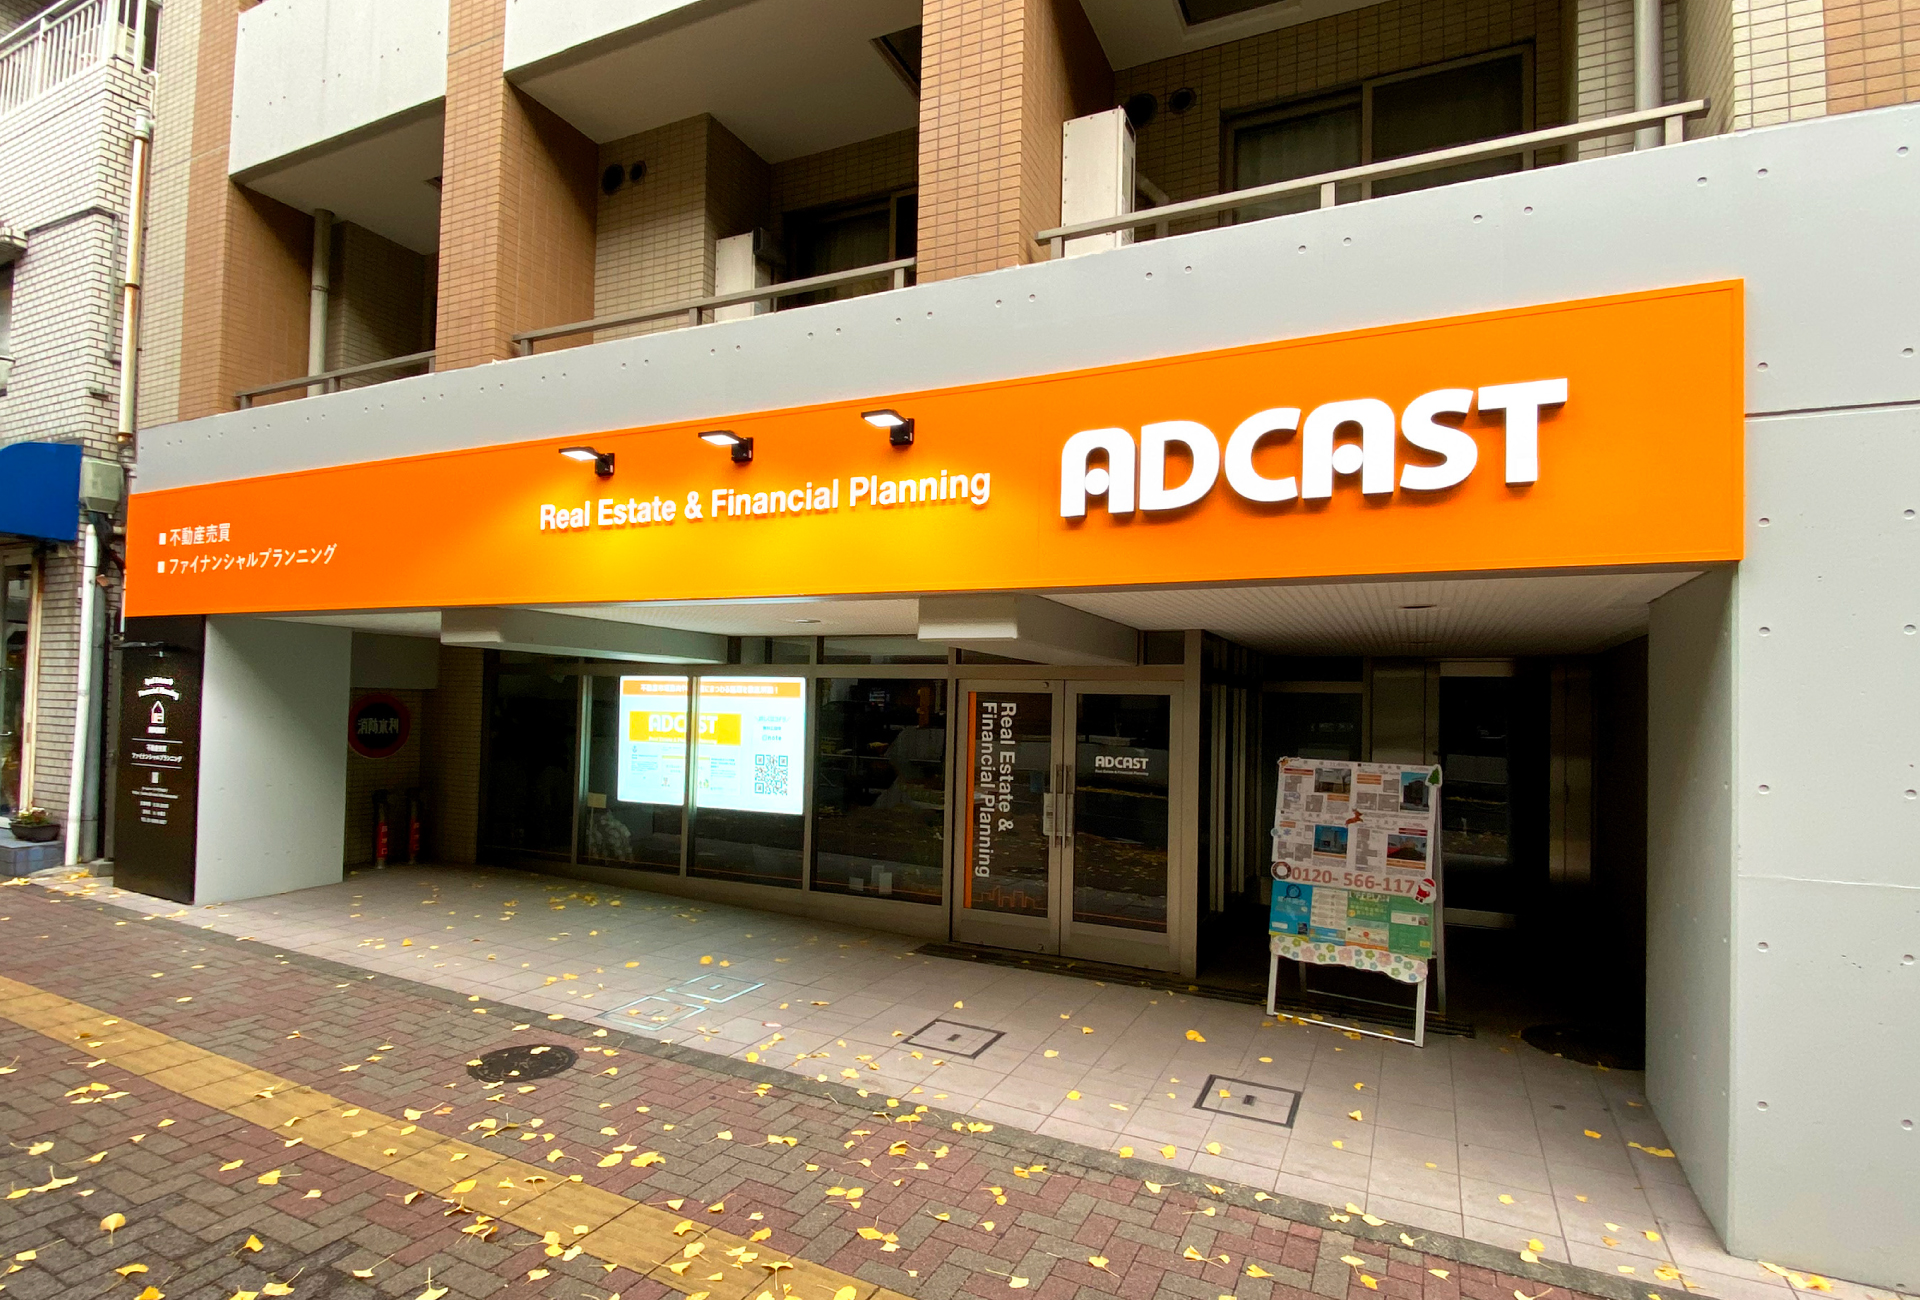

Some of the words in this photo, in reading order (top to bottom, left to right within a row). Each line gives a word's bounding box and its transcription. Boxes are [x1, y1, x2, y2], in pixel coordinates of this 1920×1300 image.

[1060, 377, 1568, 519] ADCAST
[539, 500, 591, 531] Real
[598, 495, 677, 526] Estate
[683, 490, 704, 520] &
[711, 479, 840, 518] Financial
[849, 470, 991, 506] Planning
[169, 522, 231, 547] 不動産売買
[169, 543, 338, 575] ファイナンシャルプランニング
[648, 714, 719, 734] ADCST
[1000, 702, 1017, 745] Real
[980, 702, 998, 788] Financial
[1095, 755, 1149, 770] ADCAST
[998, 751, 1016, 813] Estate
[975, 794, 996, 878] Planning
[998, 818, 1014, 832] &
[1290, 866, 1338, 884] 0120-
[1343, 872, 1415, 894] 566-117
